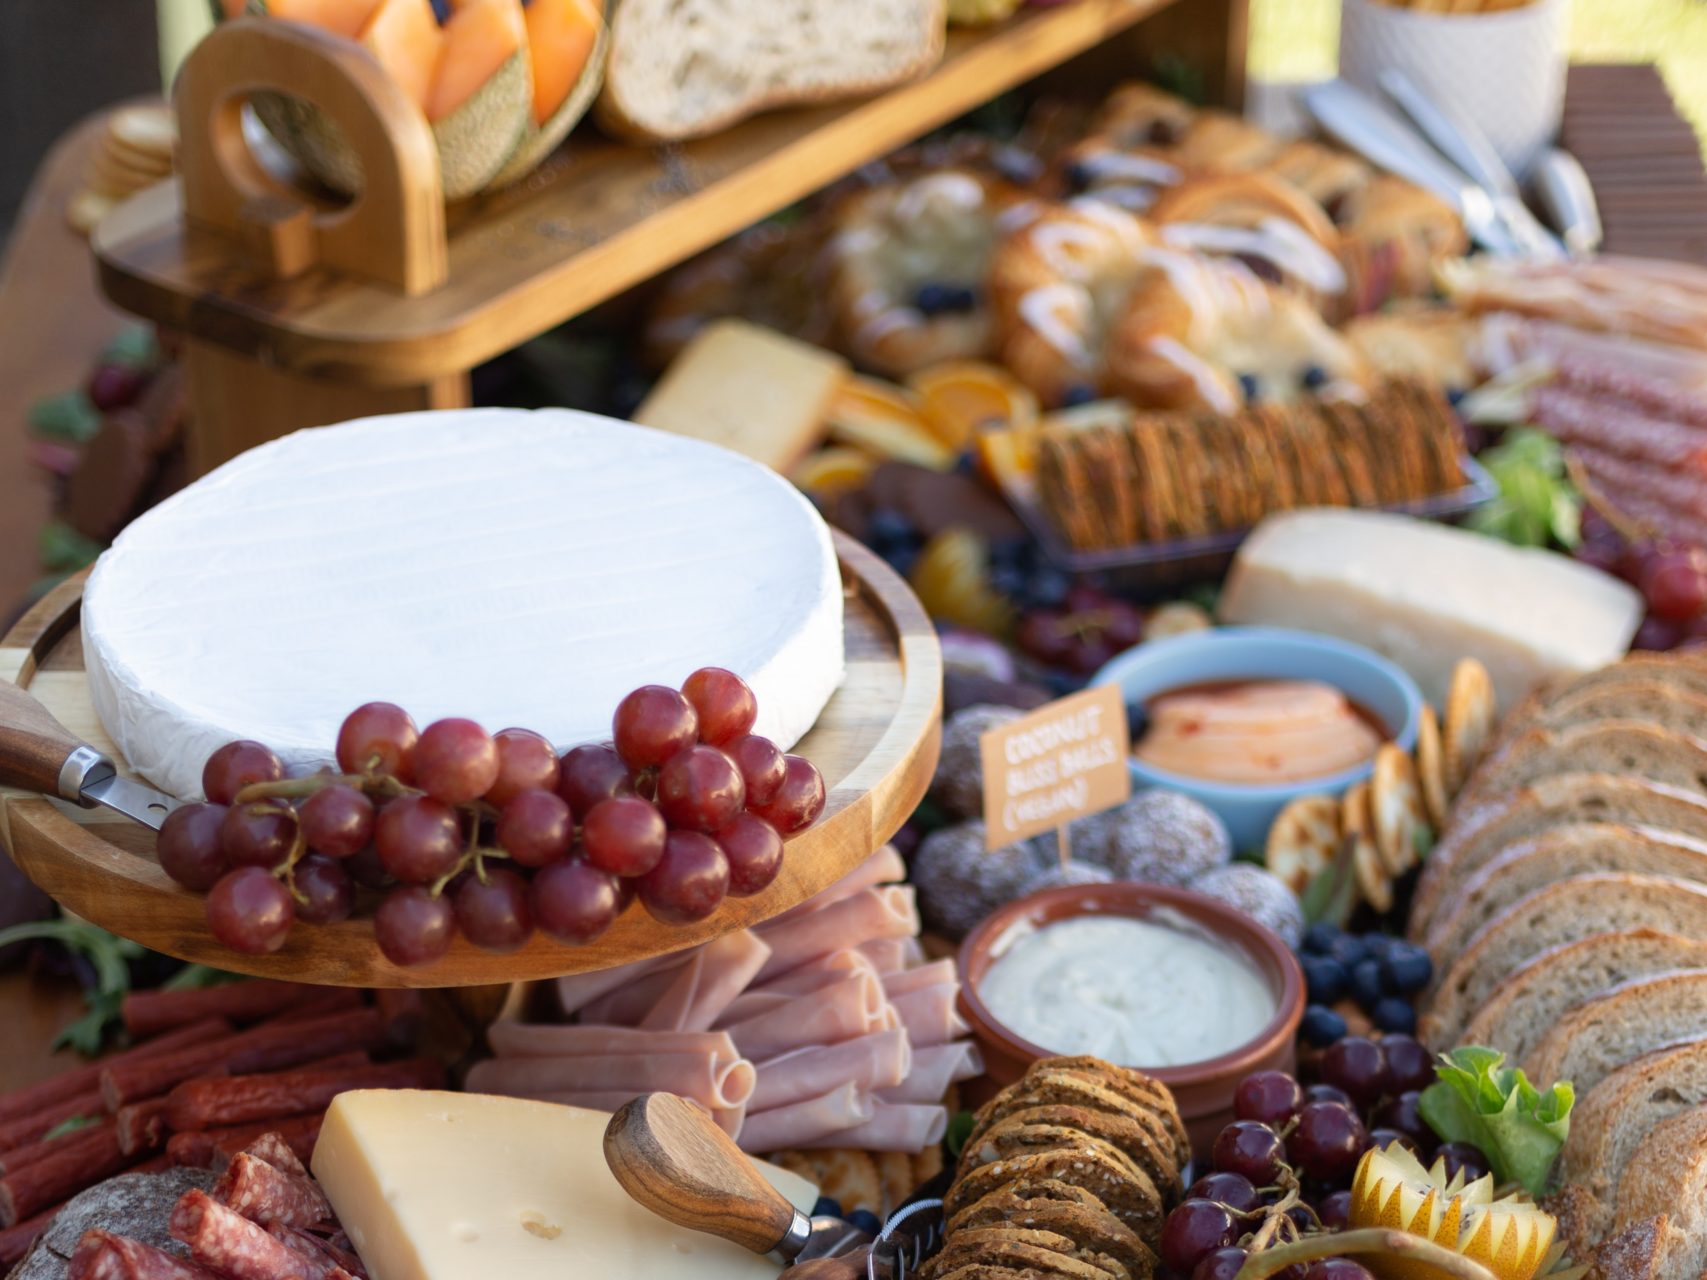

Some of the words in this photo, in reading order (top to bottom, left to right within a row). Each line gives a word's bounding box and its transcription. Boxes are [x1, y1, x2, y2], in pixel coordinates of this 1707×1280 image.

[1005, 704, 1103, 764] COCONUT
[1006, 759, 1057, 796] BLISS
[1058, 737, 1116, 778] BALLS
[1003, 777, 1088, 831] (VEGAN)
